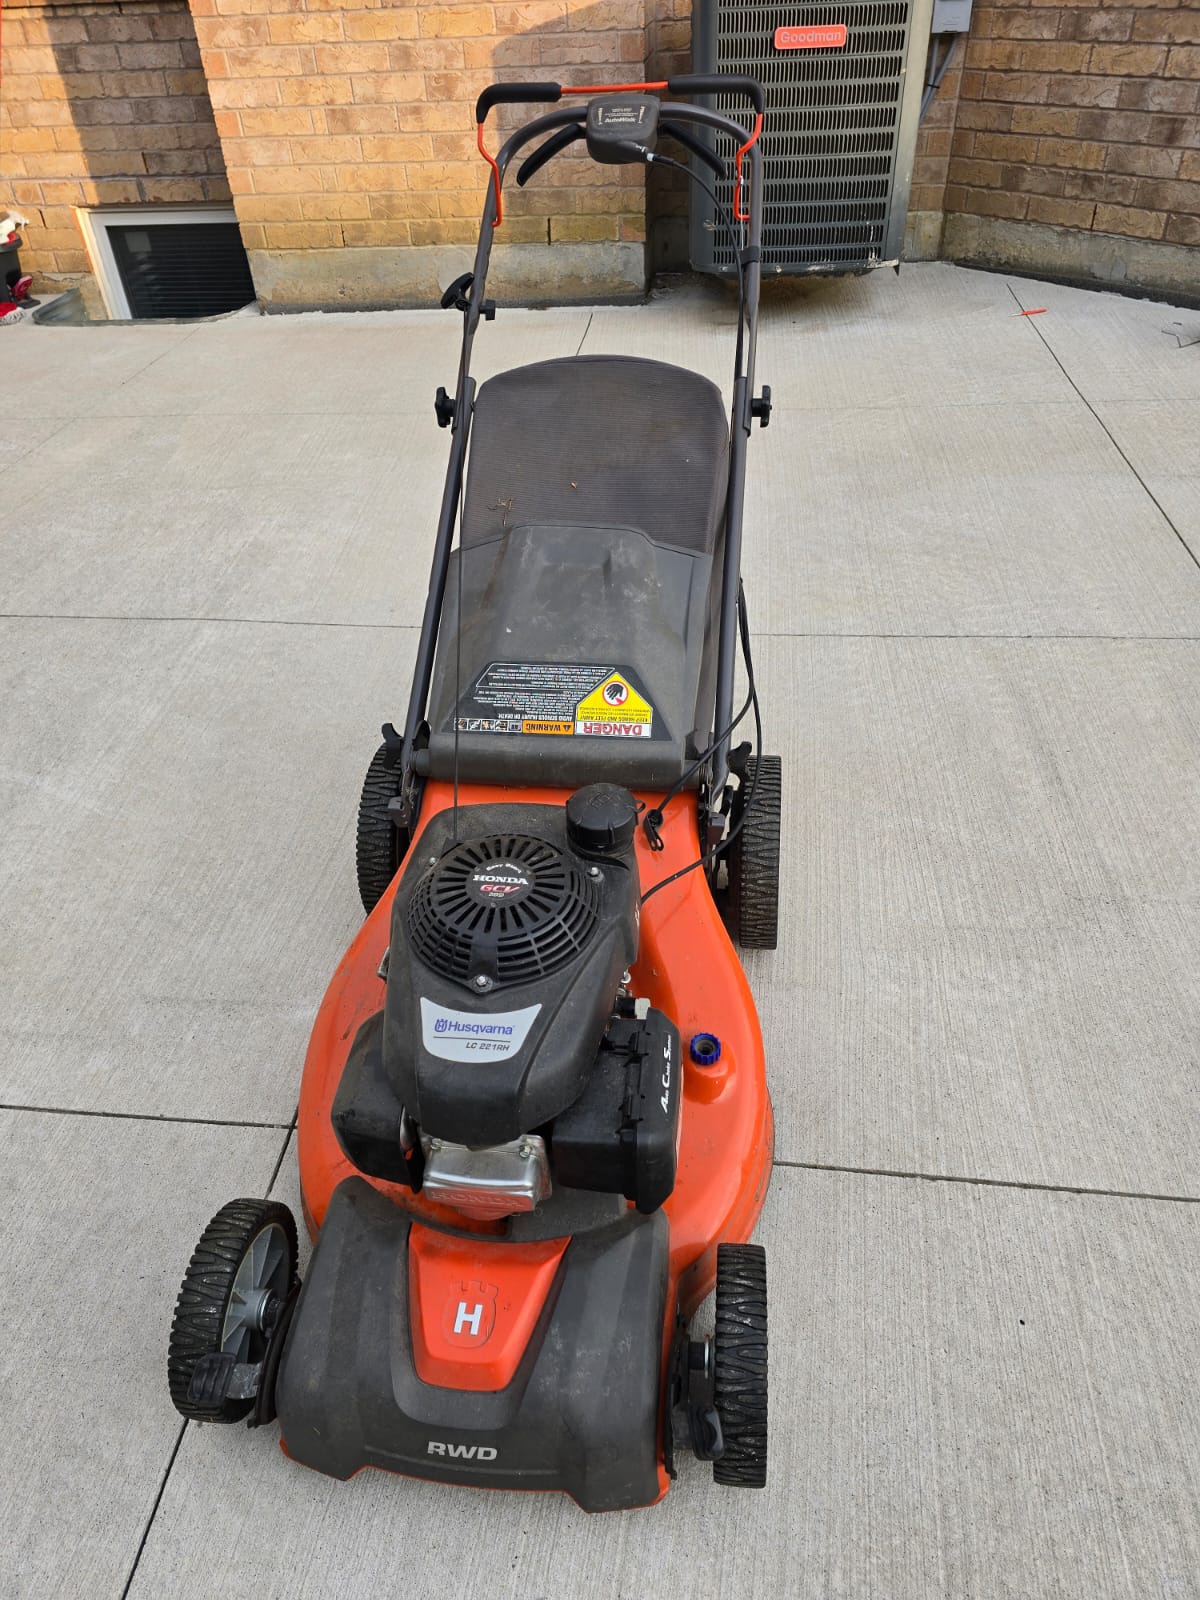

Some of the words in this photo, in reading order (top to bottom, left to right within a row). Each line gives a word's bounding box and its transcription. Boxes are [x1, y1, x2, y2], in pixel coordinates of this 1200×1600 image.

[781, 31, 841, 43] Goodman
[525, 723, 561, 732] WARNING
[583, 722, 642, 736] DANGER
[473, 875, 528, 885] HONDA
[480, 884, 522, 894] GCV
[448, 1021, 512, 1035] Husqvarna
[479, 1043, 510, 1051] 221RH
[453, 1302, 483, 1336] H
[427, 1441, 498, 1461] RWD
